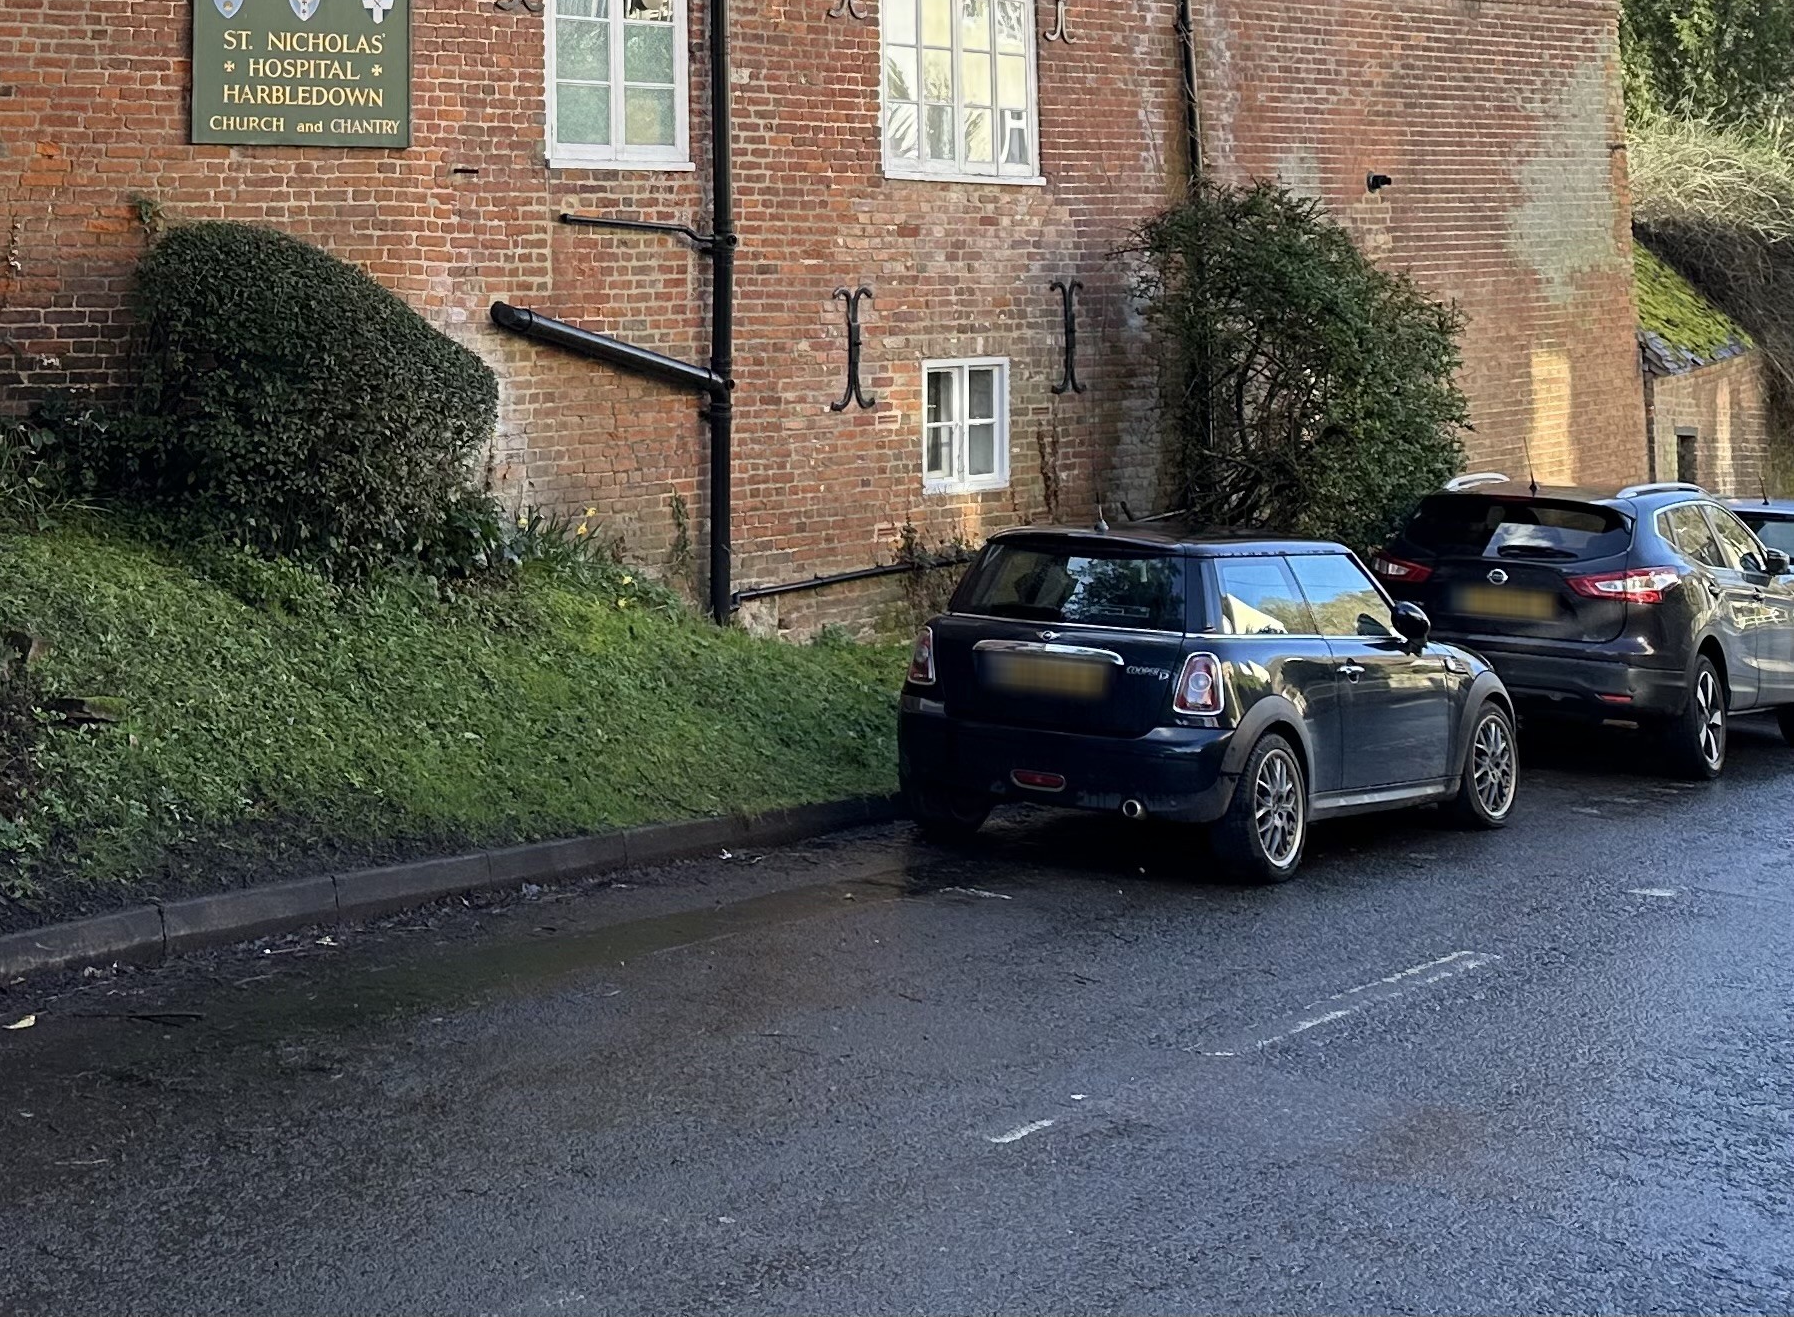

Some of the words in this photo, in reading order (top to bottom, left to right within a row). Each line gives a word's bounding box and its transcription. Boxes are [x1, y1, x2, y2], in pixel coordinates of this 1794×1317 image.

[223, 30, 253, 50] ST.
[267, 31, 386, 54] NICHOLAS'
[248, 58, 361, 80] HOSPITAL
[223, 85, 383, 107] HARBLEDOWN
[209, 115, 285, 132] CHURCH
[296, 120, 323, 133] and
[330, 118, 400, 135] CHANTRY
